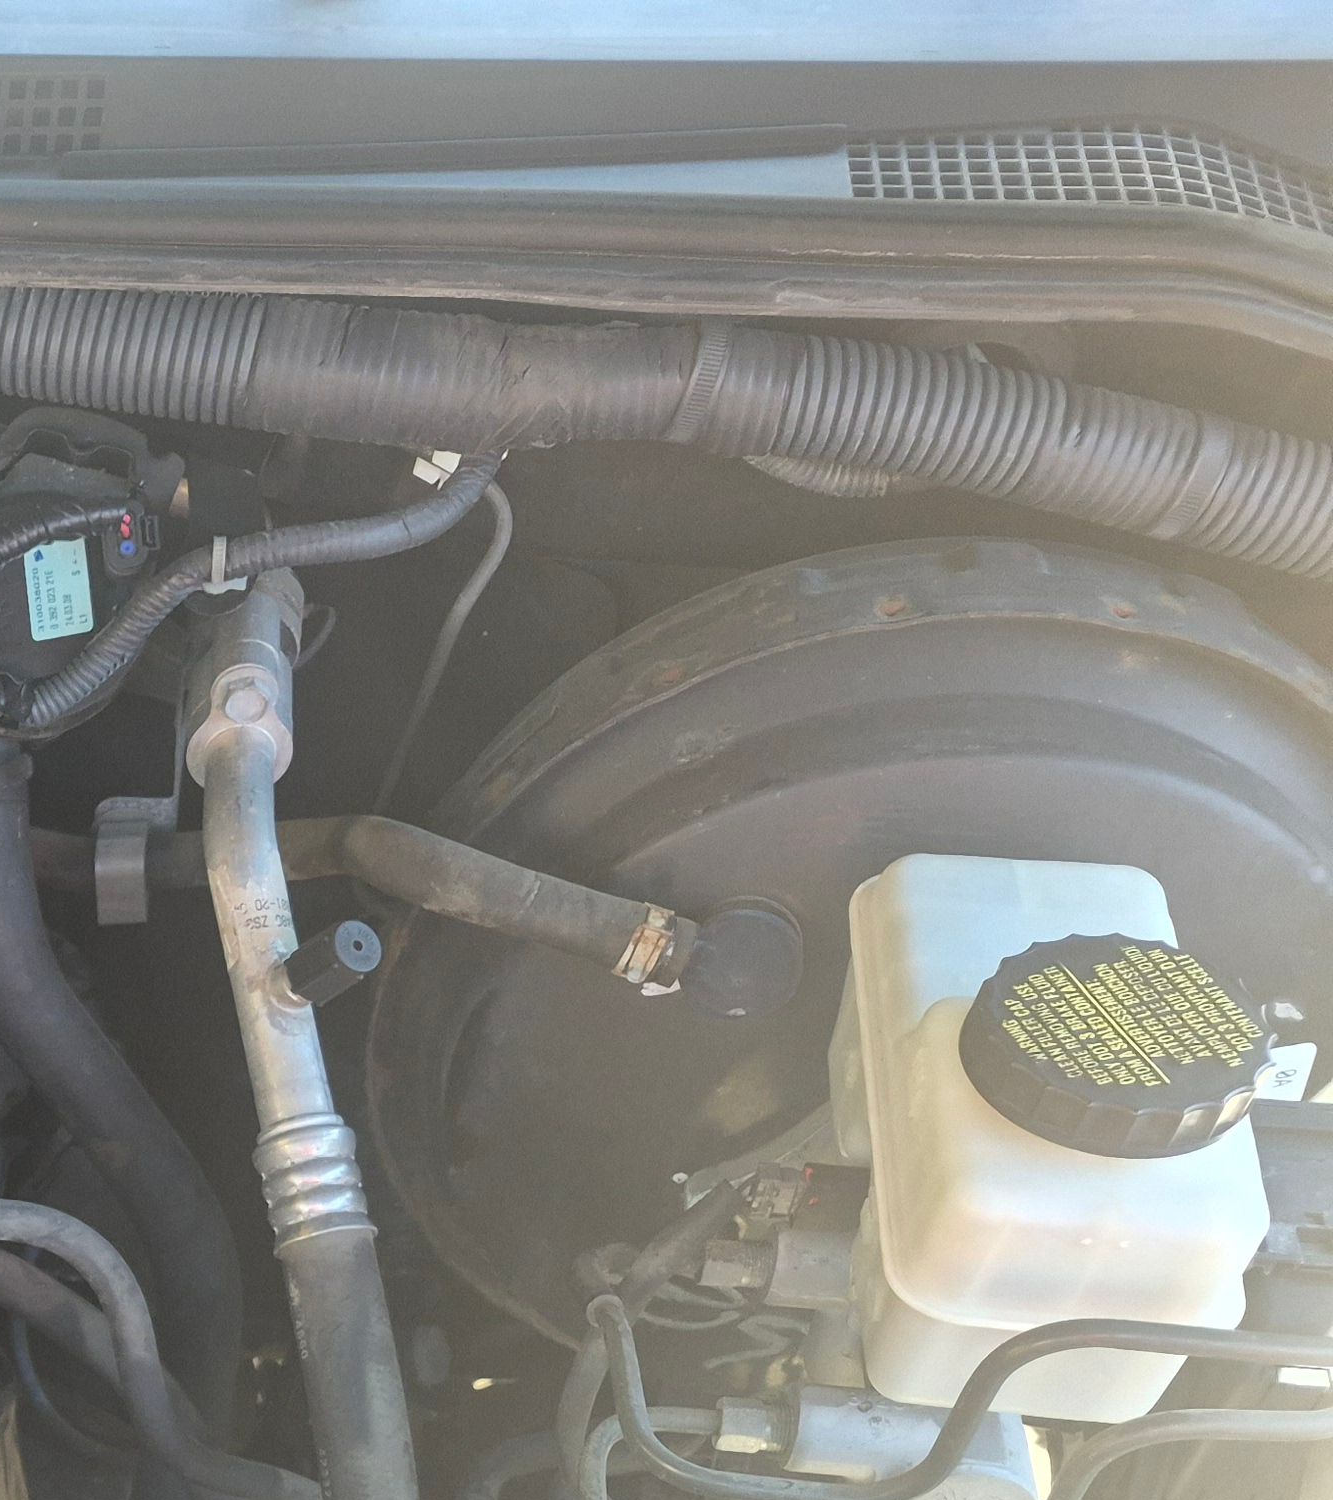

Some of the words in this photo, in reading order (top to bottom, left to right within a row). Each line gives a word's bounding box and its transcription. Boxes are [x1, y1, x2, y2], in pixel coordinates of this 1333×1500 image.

[1013, 982, 1038, 1001] USE
[1028, 973, 1060, 1000] FLUID
[1042, 965, 1097, 1017] CONTAINER
[1093, 963, 1141, 1006] BOUCHON
[1150, 977, 1174, 992] DU
[1167, 970, 1226, 1024] PROVENANT
[1004, 999, 1031, 1018] CAP
[1050, 999, 1088, 1031] BRAKE
[1131, 1004, 1152, 1019] LE
[1163, 992, 1192, 1011] QUE
[1202, 985, 1264, 1039] CONTENANT
[1021, 1017, 1058, 1048] FILLER
[1030, 1002, 1081, 1050] REMOVING
[1087, 1016, 1128, 1051] SEALED
[1160, 1013, 1184, 1028] DE
[1087, 1042, 1116, 1061] DOT
[1118, 1050, 1136, 1059] A
[1142, 1017, 1196, 1065] NETTOYER
[1173, 1027, 1214, 1058] AVANT
[1224, 1032, 1254, 1052] DOT
[1048, 1047, 1084, 1079] CLEAN
[1073, 1049, 1114, 1086] BEFORE
[1104, 1062, 1136, 1085] ONLY
[1125, 1058, 1163, 1087] FROM
